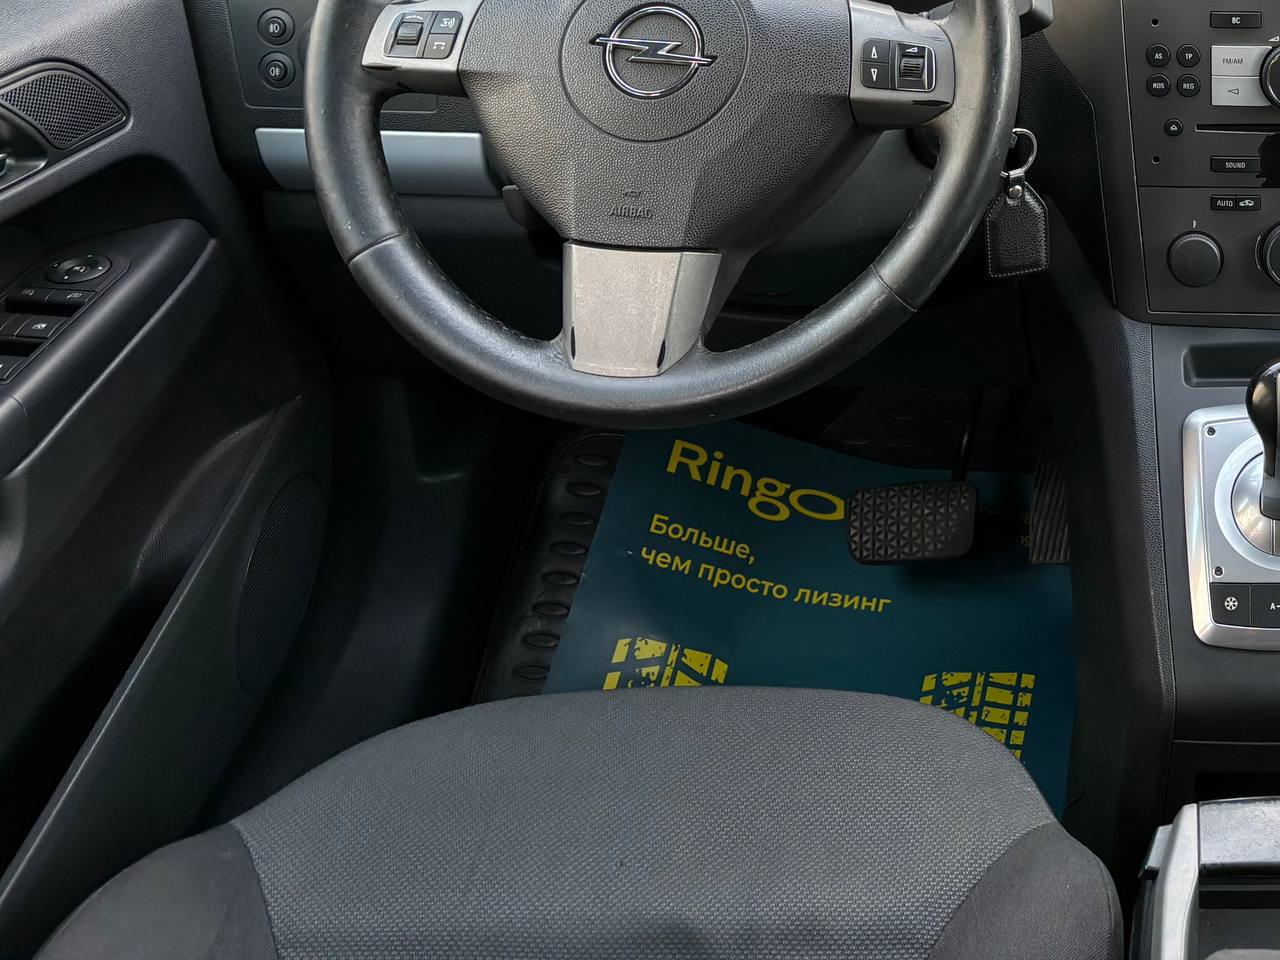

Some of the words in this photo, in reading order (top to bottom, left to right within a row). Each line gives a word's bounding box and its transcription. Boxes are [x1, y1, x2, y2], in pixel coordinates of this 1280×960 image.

[1231, 16, 1241, 24] BC
[1222, 57, 1244, 65] FM/AM
[1182, 82, 1195, 90] REG
[1225, 161, 1246, 169] SOUND
[1216, 199, 1234, 207] AUTO
[609, 205, 652, 218] AIRBAG
[649, 512, 756, 565] Больше,
[640, 546, 692, 576] чем
[698, 563, 790, 600] просто
[793, 586, 892, 614] лизинг
[1269, 602, 1276, 610] A
